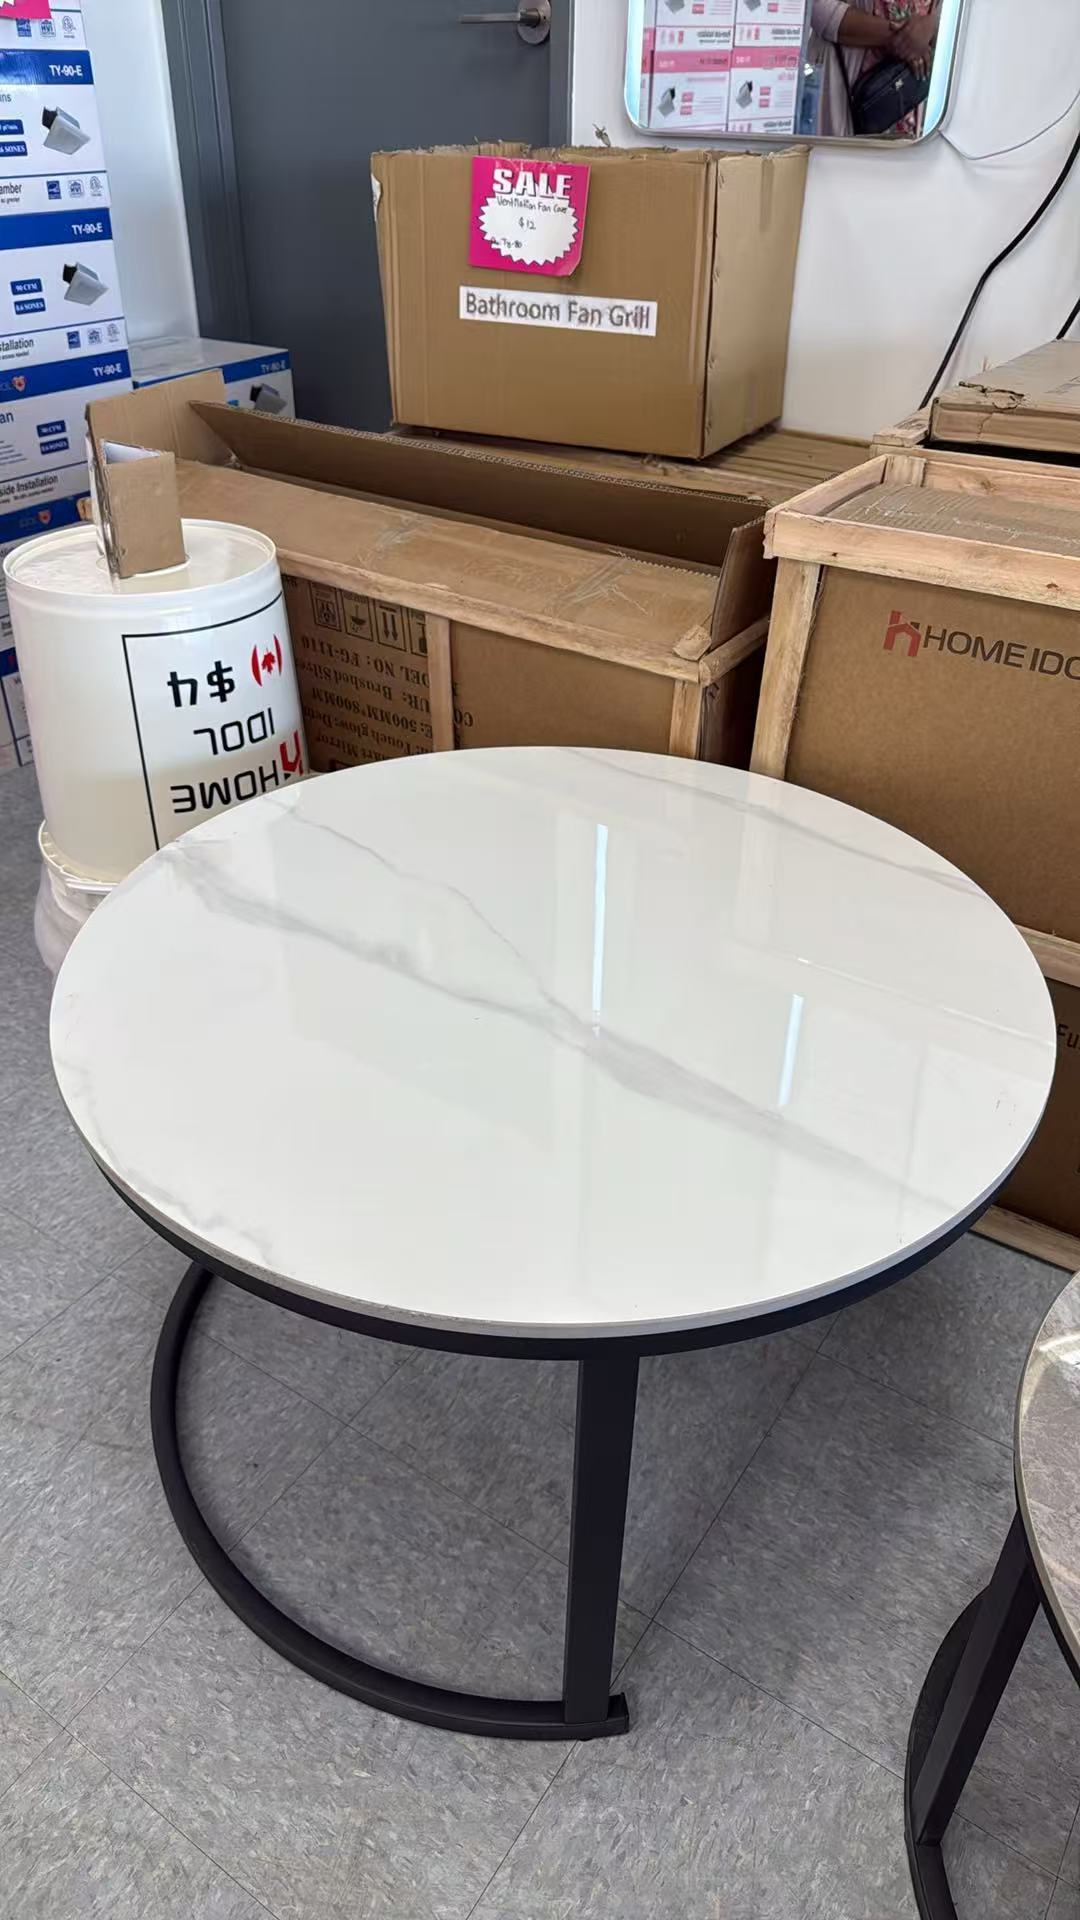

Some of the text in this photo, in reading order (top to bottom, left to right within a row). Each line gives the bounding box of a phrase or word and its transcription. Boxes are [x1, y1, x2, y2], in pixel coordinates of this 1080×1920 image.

[48, 64, 83, 77] TY-90-E
[493, 168, 573, 200] SALE
[537, 202, 552, 212] Fan
[71, 222, 104, 236] TY-90-E
[518, 216, 537, 231] $12
[465, 292, 651, 329] Bathroom Fan Grill
[166, 660, 236, 709] $4
[333, 670, 393, 700] Brushed
[192, 707, 276, 757] IDOL
[169, 759, 281, 814] HOME
